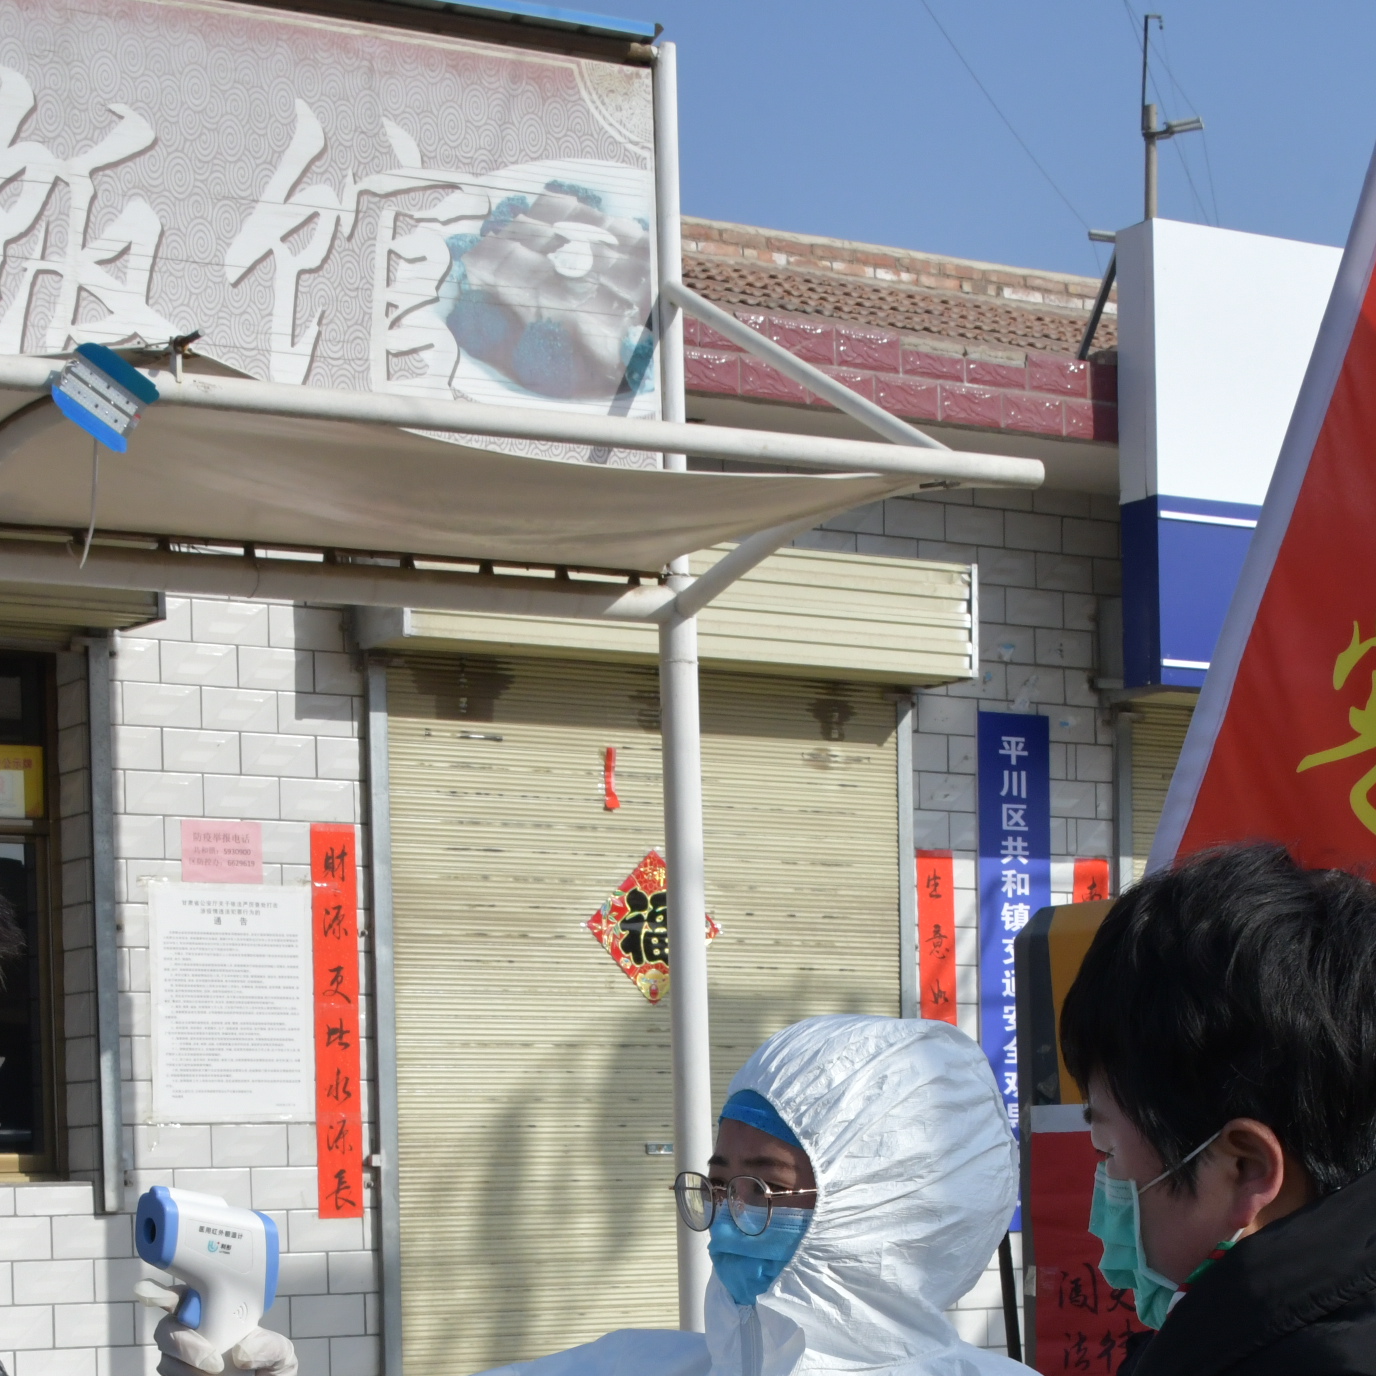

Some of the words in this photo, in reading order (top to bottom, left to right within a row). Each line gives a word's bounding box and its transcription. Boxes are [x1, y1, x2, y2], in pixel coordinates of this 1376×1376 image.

[192, 832, 250, 844] 防疫举报电话
